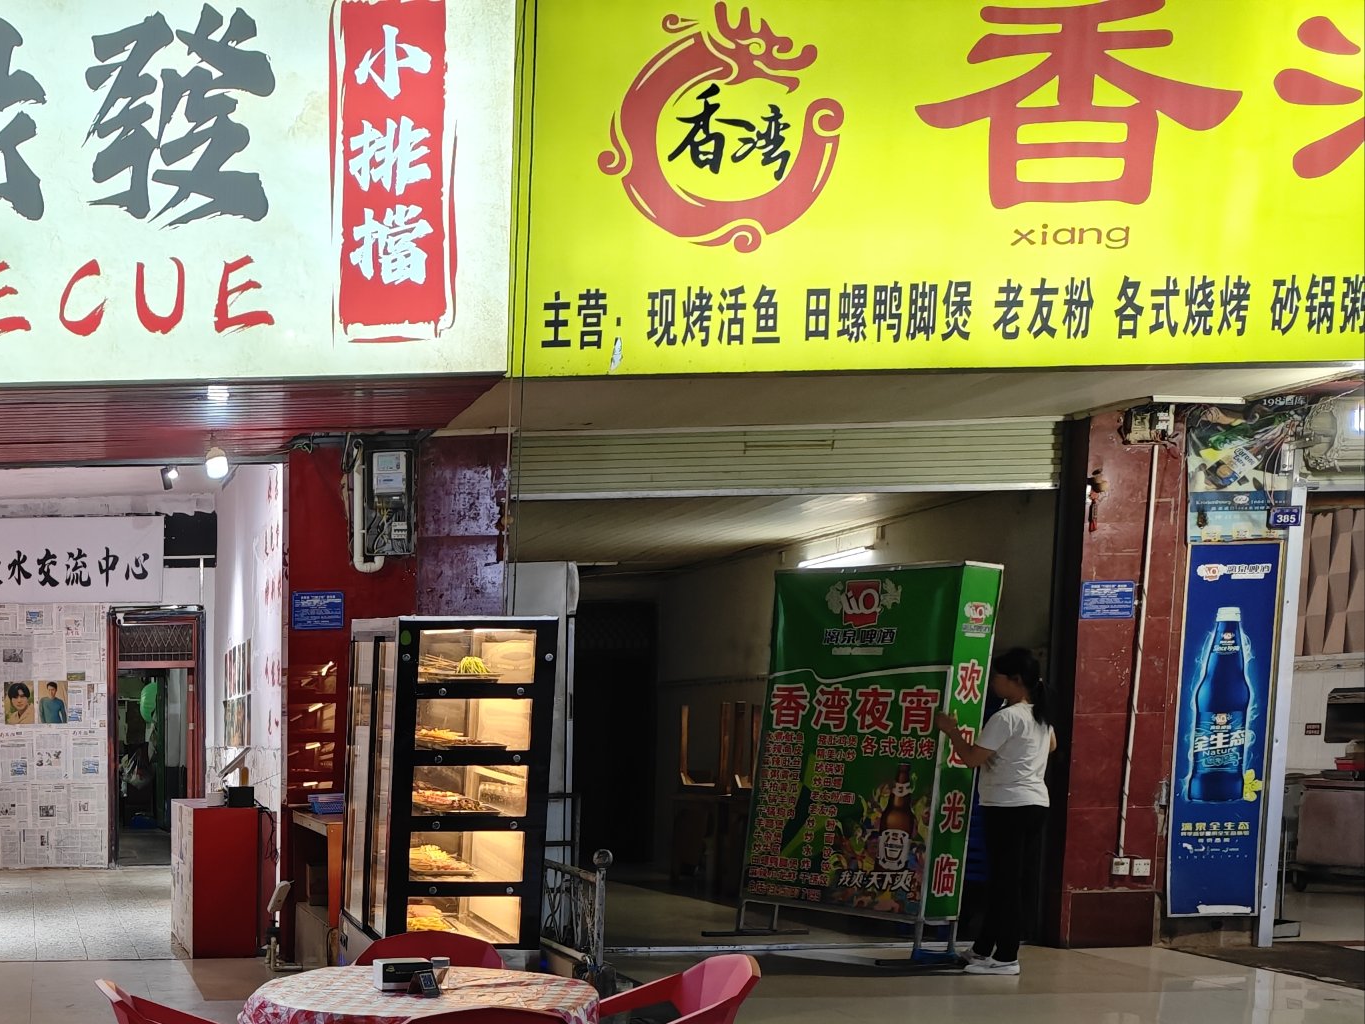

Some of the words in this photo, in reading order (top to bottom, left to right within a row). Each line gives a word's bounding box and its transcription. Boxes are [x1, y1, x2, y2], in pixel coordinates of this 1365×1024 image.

[666, 84, 792, 182] 香湾
[915, 0, 1365, 209] 香
[349, 23, 434, 288] 小排擋
[1010, 224, 1131, 250] xiang
[646, 285, 782, 349] 现烤活鱼
[804, 277, 973, 344] 田螺鸭脚煲
[993, 277, 1094, 341] 老友粉
[1115, 275, 1251, 339] 各式烧烤
[1276, 514, 1296, 523] 385
[770, 684, 940, 735] 香湾夜宵
[861, 735, 935, 760] 各式烧烤
